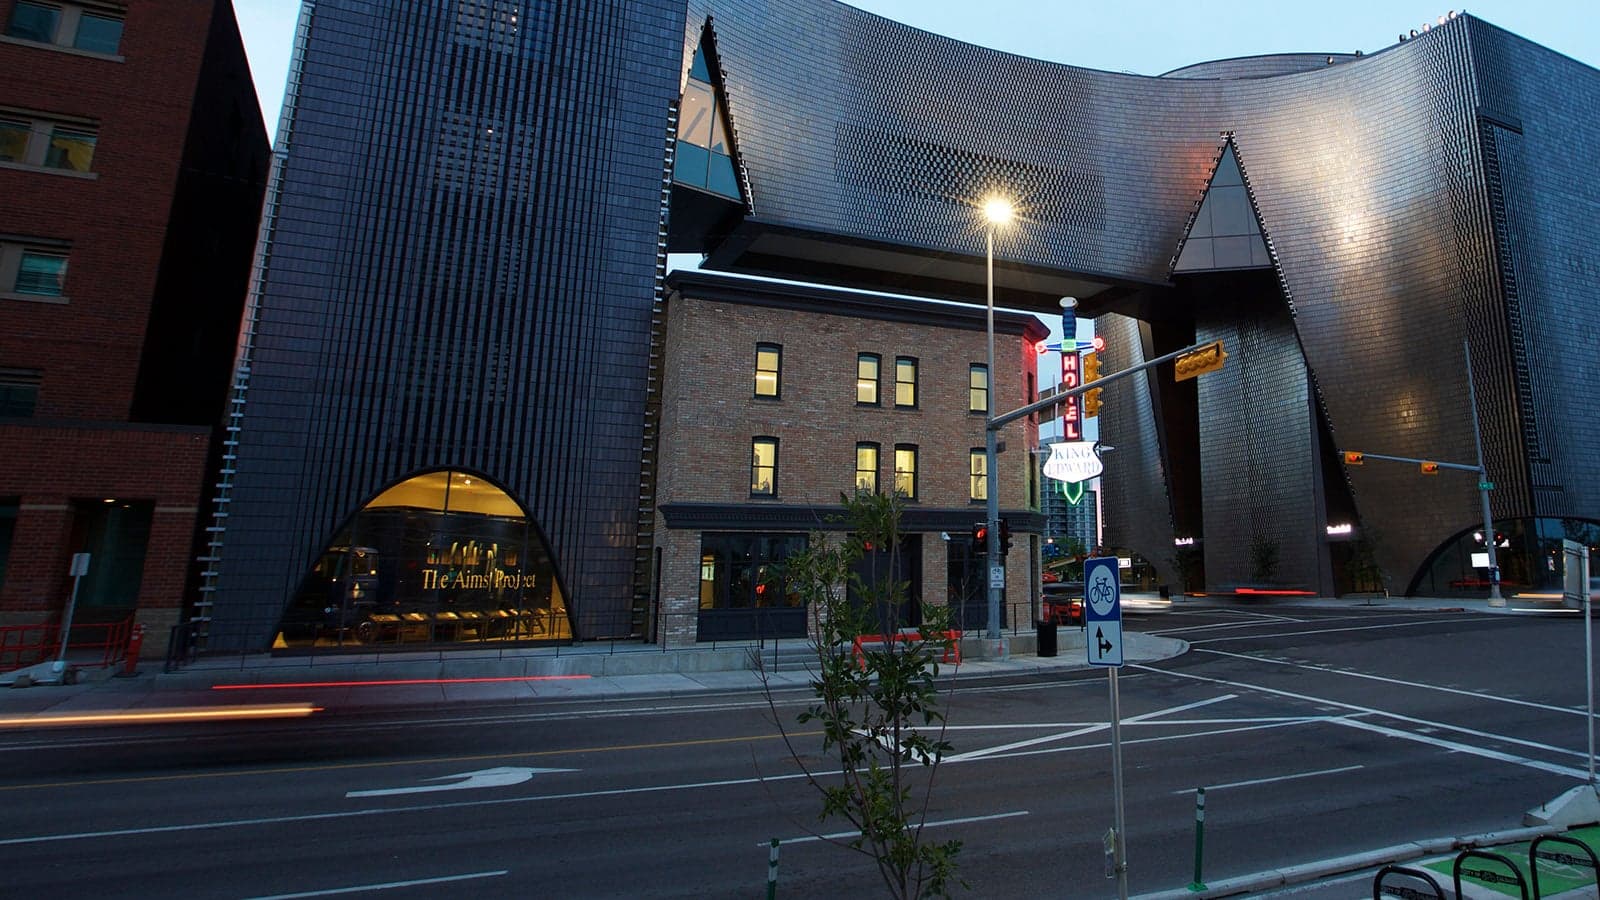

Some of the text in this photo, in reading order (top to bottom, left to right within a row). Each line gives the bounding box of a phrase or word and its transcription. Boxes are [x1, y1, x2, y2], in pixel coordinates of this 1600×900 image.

[1063, 355, 1078, 438] HOEL
[1054, 446, 1091, 460] KING
[1047, 462, 1100, 475] EDWARD
[422, 569, 449, 589] The
[451, 569, 488, 590] Aims
